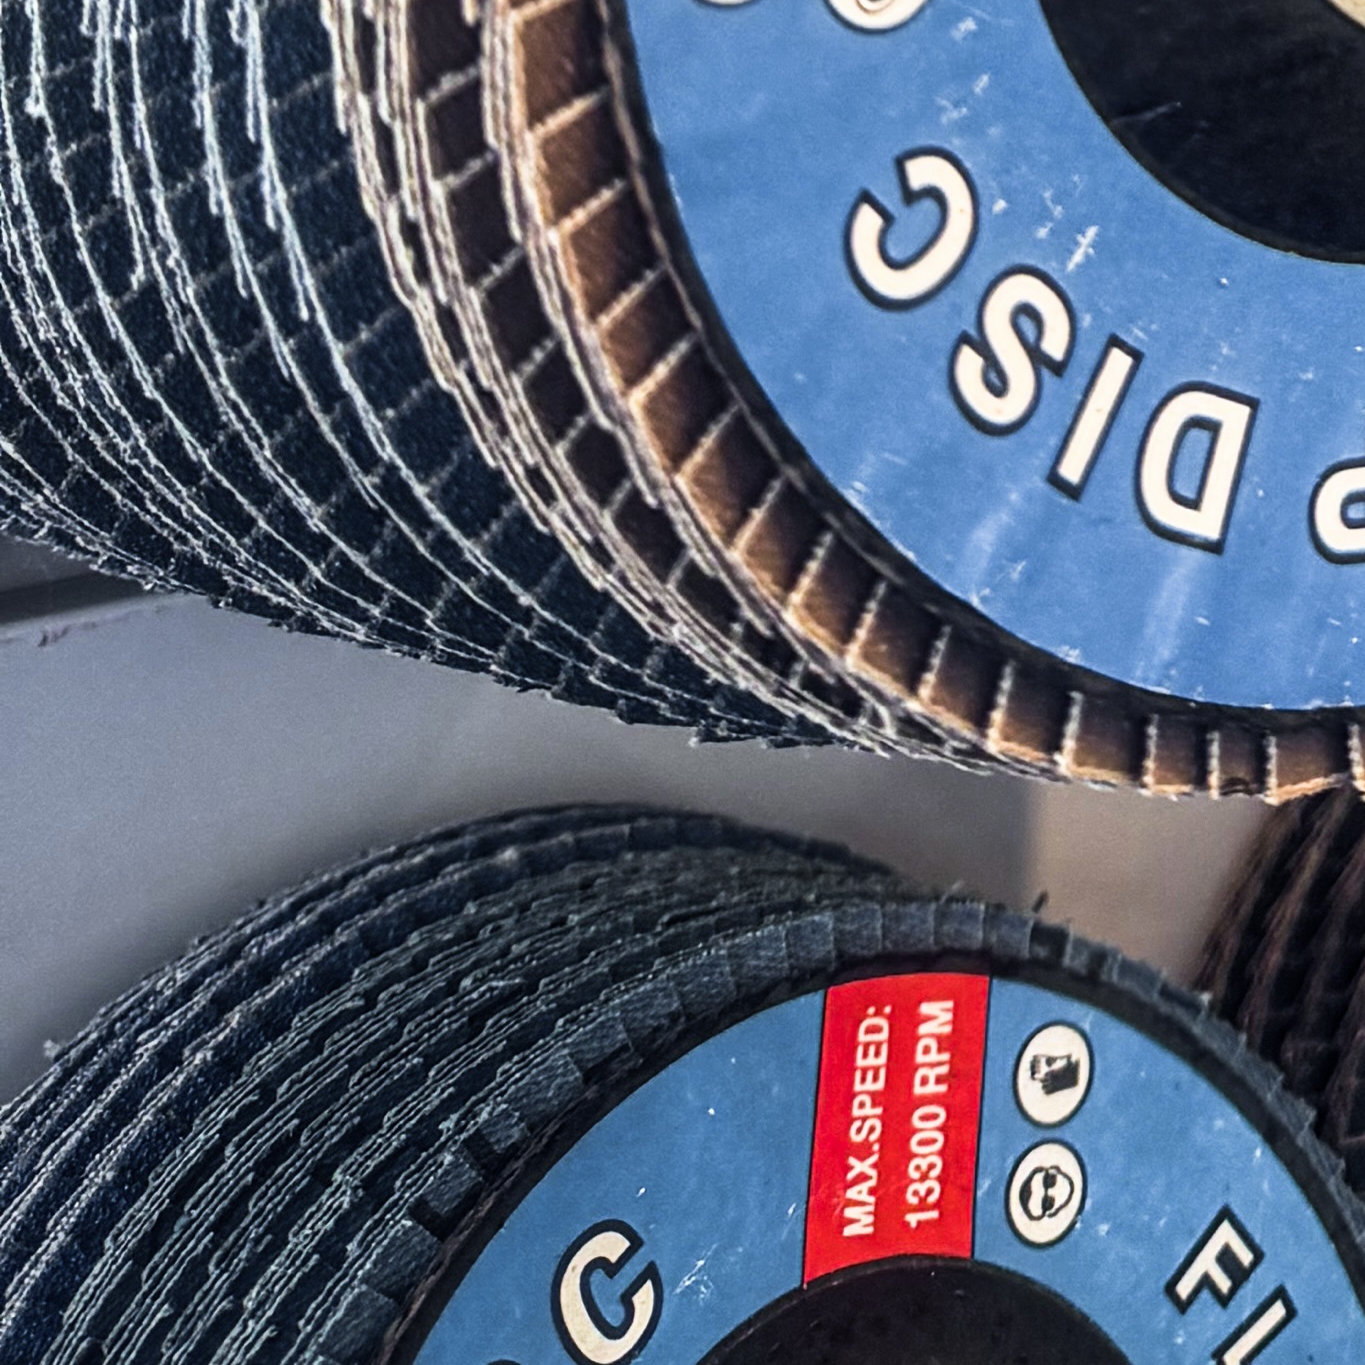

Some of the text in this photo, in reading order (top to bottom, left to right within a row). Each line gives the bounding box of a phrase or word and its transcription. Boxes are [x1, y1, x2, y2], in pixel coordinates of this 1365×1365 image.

[844, 146, 1260, 554] DISC
[841, 1001, 895, 1241] MAX.SPEED:
[904, 997, 957, 1231] 13300 RPM
